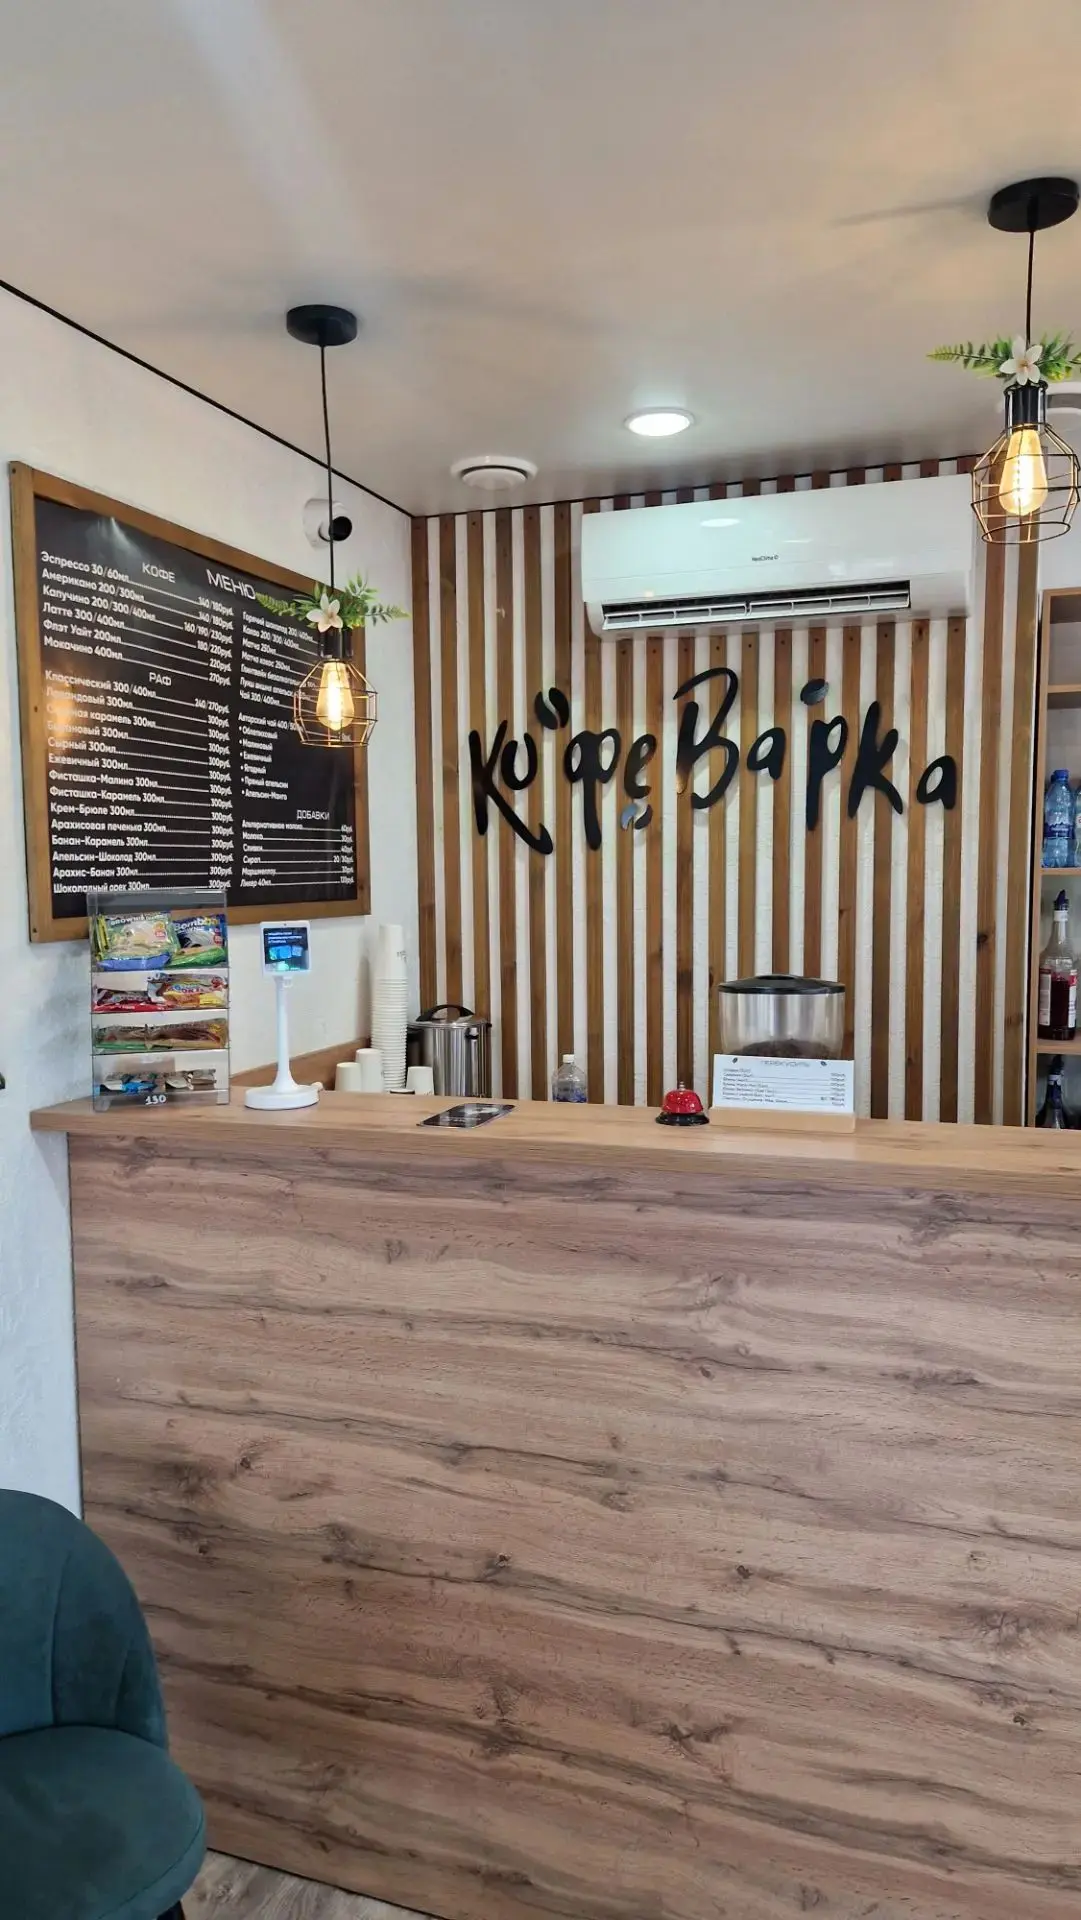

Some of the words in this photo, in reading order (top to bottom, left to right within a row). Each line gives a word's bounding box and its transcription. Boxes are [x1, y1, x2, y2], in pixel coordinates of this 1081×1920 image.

[41, 551, 90, 572] Эспрессо
[91, 563, 129, 582] 30/60мл
[142, 562, 176, 583] КОФЕ
[42, 568, 97, 590] Американо
[98, 582, 144, 601] 200/300мл
[206, 569, 256, 600] МЕНЮ
[43, 584, 90, 604] Капучино
[91, 596, 155, 621] 200/300/400мл
[43, 602, 73, 618] Латте
[74, 608, 125, 629] 300/400мл
[43, 619, 68, 633] Флэт
[70, 624, 92, 637] Уайт
[93, 629, 122, 643] 200мл
[44, 635, 93, 655] Мокачино
[94, 645, 123, 659] 400мл
[45, 670, 112, 690] Классический
[112, 681, 156, 697] 300/400мл
[149, 672, 171, 686] РАФ
[106, 696, 133, 709] 300мл
[46, 704, 88, 718] Сная
[90, 709, 131, 725] карамель
[133, 716, 156, 728] 300мл
[47, 721, 100, 736] Бановый
[101, 726, 129, 739] 300мл
[48, 736, 86, 751] Сырный
[88, 741, 116, 753] 300мл
[48, 753, 100, 767] Ежевичный
[101, 758, 128, 770] 300мл
[49, 769, 134, 786] Фисташка-Малина
[135, 777, 158, 788] 300мл
[49, 786, 141, 802] Фисташка-Карамель
[142, 792, 165, 803] 300мл
[50, 802, 108, 816] Крем-Брюле
[109, 805, 135, 816] 300мл
[296, 810, 330, 820] ДОБАВКИ
[51, 818, 106, 831] Арахисовая
[107, 823, 142, 831] печенька
[143, 822, 166, 832] 300мл
[51, 835, 125, 848] Банан-Карамель
[126, 837, 148, 847] 300мл
[52, 851, 133, 862] Апельсин-Шоколад
[134, 852, 156, 861] 300мл
[53, 867, 115, 879] Арахис-Банан
[116, 867, 138, 877] 300мл
[128, 881, 150, 891] 300мл
